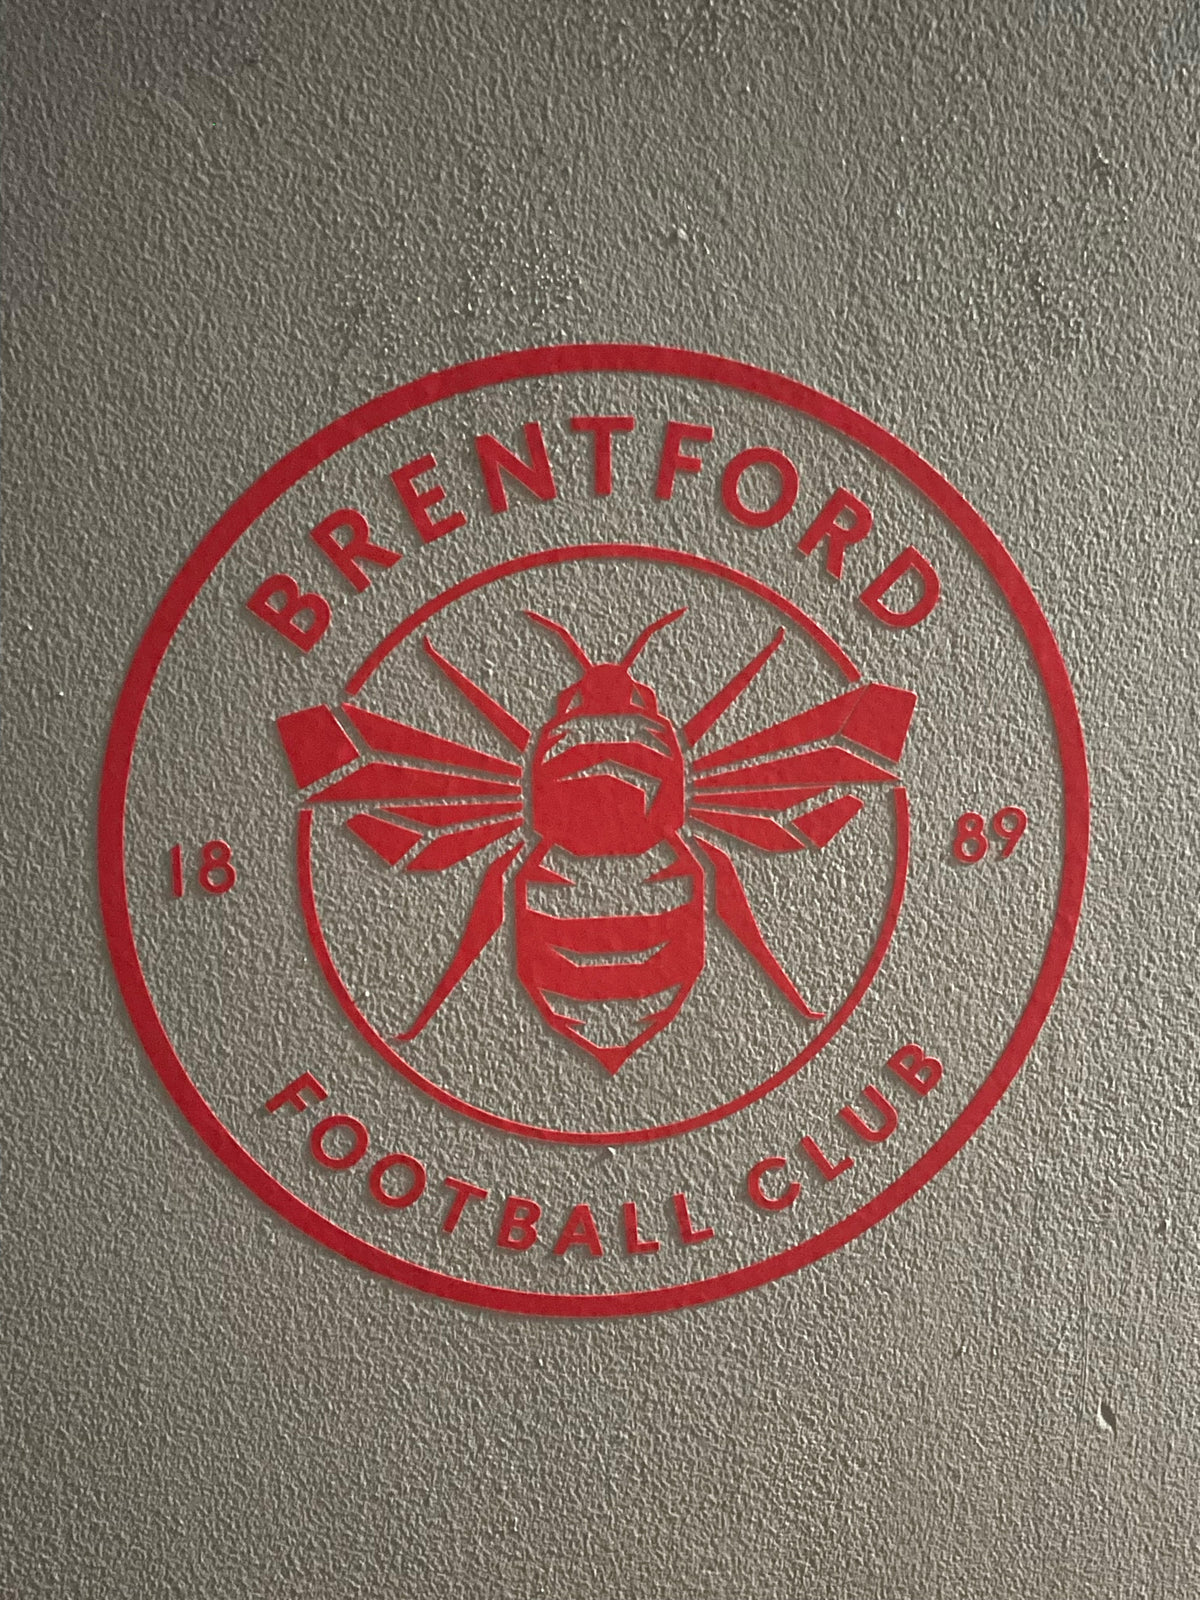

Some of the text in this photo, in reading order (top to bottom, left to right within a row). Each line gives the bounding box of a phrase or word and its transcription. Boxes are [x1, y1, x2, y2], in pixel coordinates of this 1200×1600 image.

[246, 415, 941, 653] BRENTFORD
[170, 839, 237, 897] 18
[953, 806, 1029, 863] 89
[265, 1043, 944, 1257] FOOTBALL CLUB
